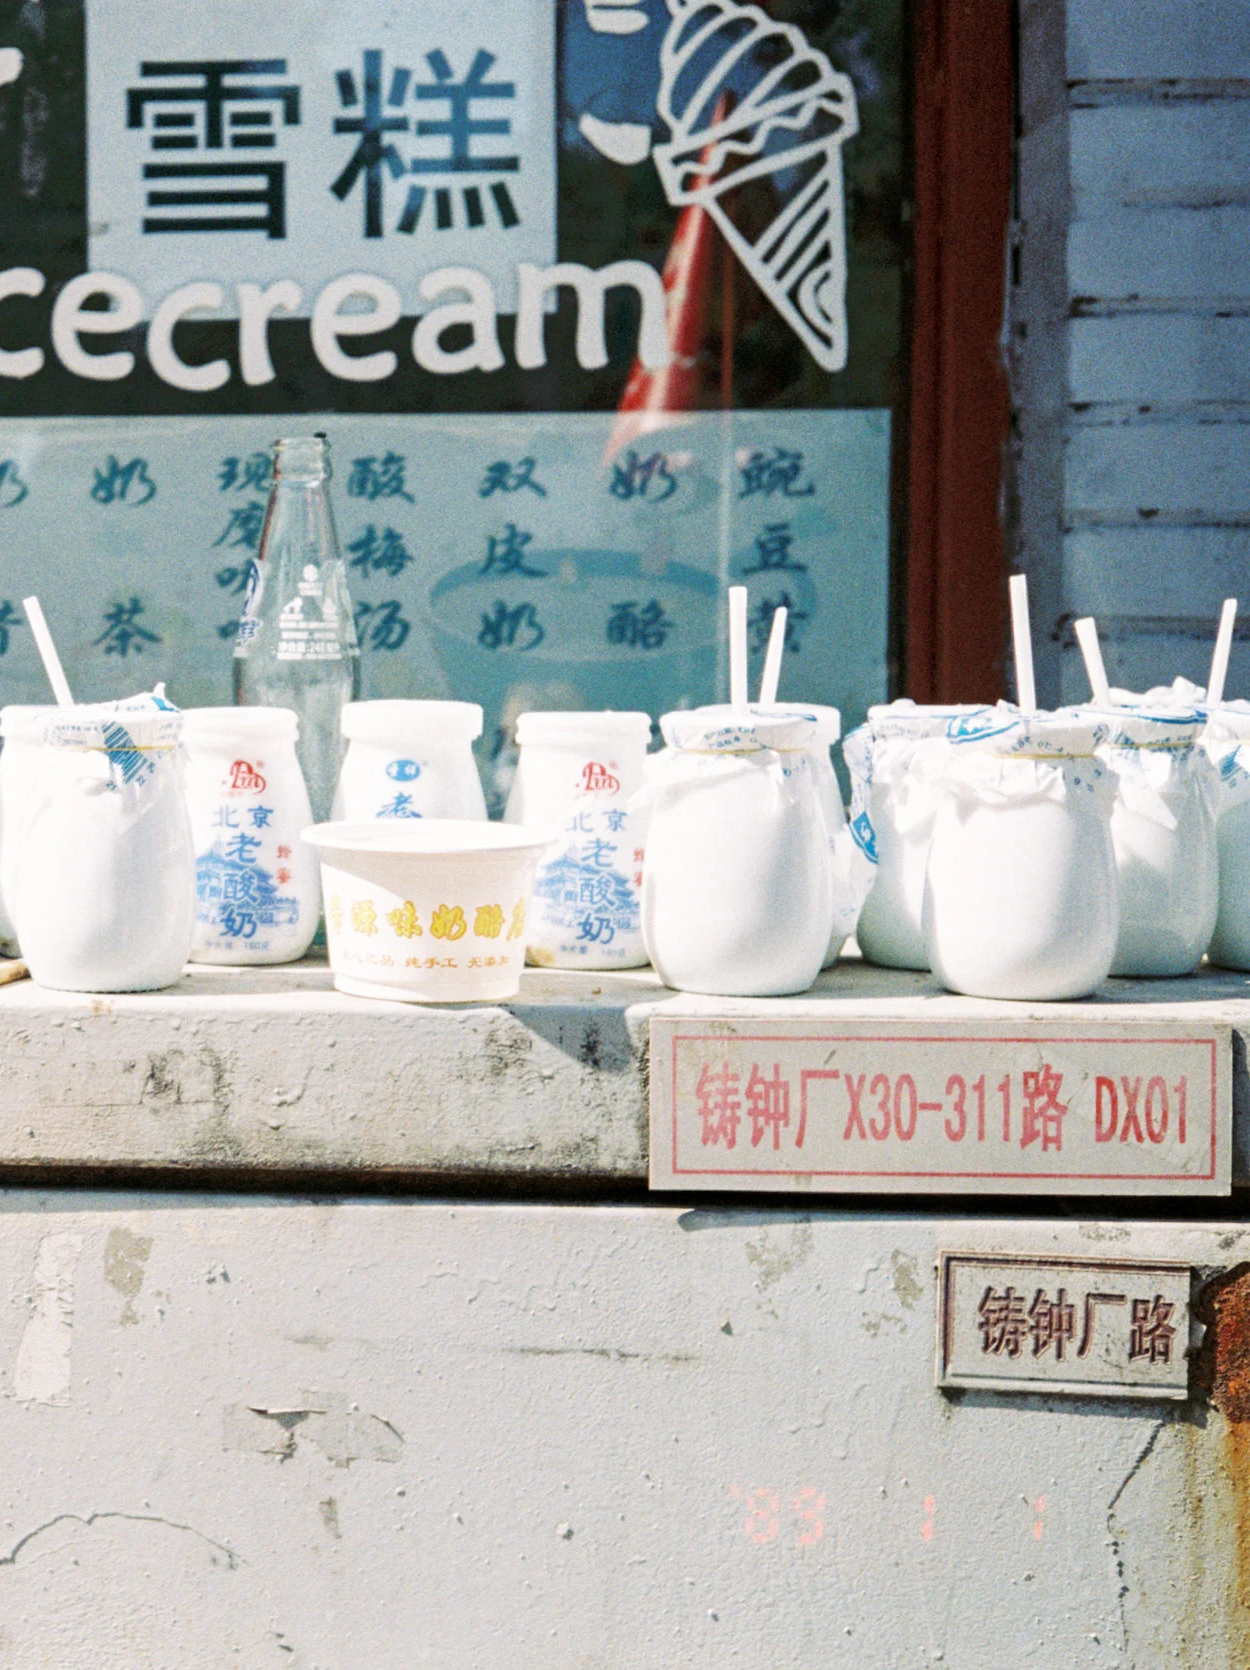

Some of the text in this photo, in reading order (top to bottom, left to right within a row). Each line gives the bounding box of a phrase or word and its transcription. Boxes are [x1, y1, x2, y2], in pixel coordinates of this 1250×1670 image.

[126, 48, 520, 239] 雪糕
[91, 454, 162, 659] 奶茶
[347, 450, 414, 652] 酸梅汤
[479, 456, 548, 651] 双皮奶
[605, 449, 677, 650] 奶酪
[211, 805, 274, 829] 北京
[565, 808, 628, 832] 北京
[219, 832, 263, 939] 老酸奶
[576, 838, 618, 944] 老酸奶
[1095, 1076, 1188, 1145] DX01
[977, 1285, 1177, 1365] 铸钟厂路
